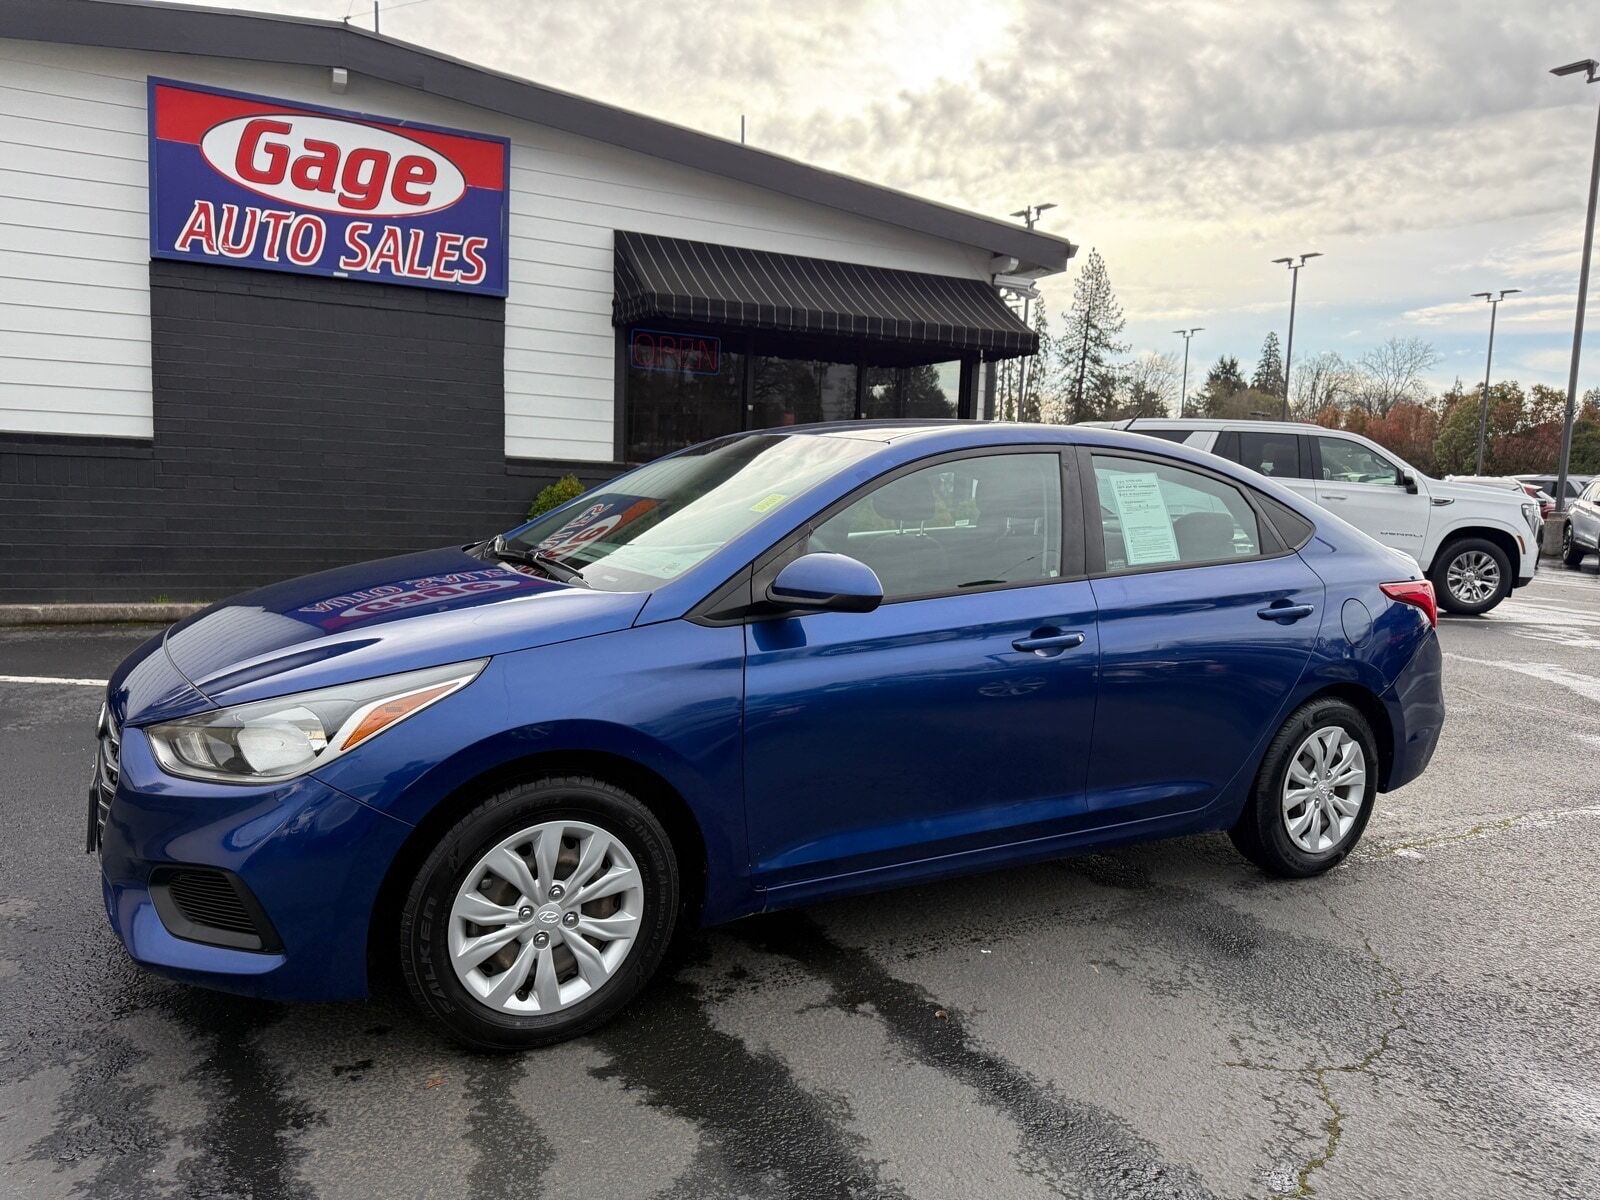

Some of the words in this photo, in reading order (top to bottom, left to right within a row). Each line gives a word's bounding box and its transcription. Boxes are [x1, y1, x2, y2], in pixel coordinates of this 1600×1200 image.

[235, 119, 437, 210] Gage
[175, 200, 327, 266] AUTO
[340, 222, 488, 285] SALES
[634, 333, 718, 370] OPEN
